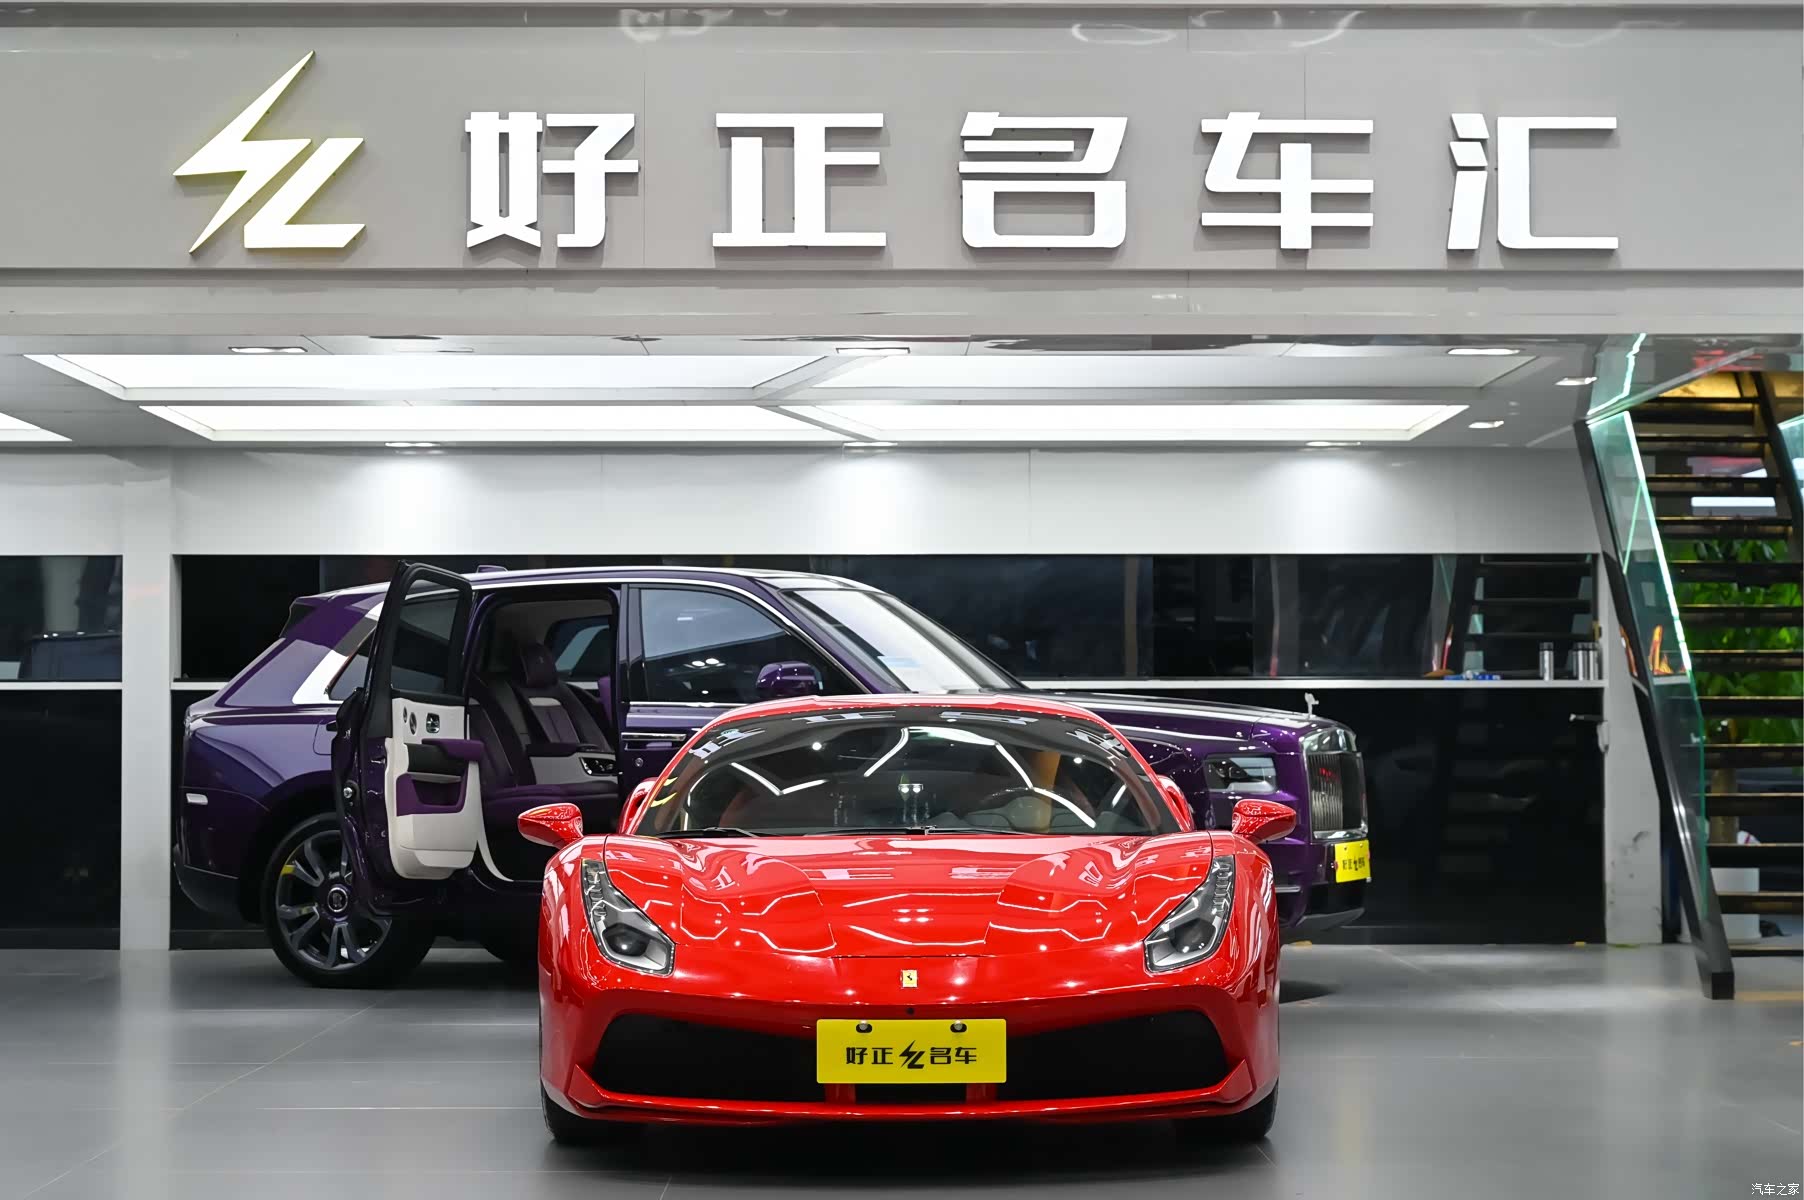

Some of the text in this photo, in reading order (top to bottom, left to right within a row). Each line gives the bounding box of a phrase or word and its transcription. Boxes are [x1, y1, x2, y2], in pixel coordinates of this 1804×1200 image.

[464, 110, 1620, 250] 好正名车汇
